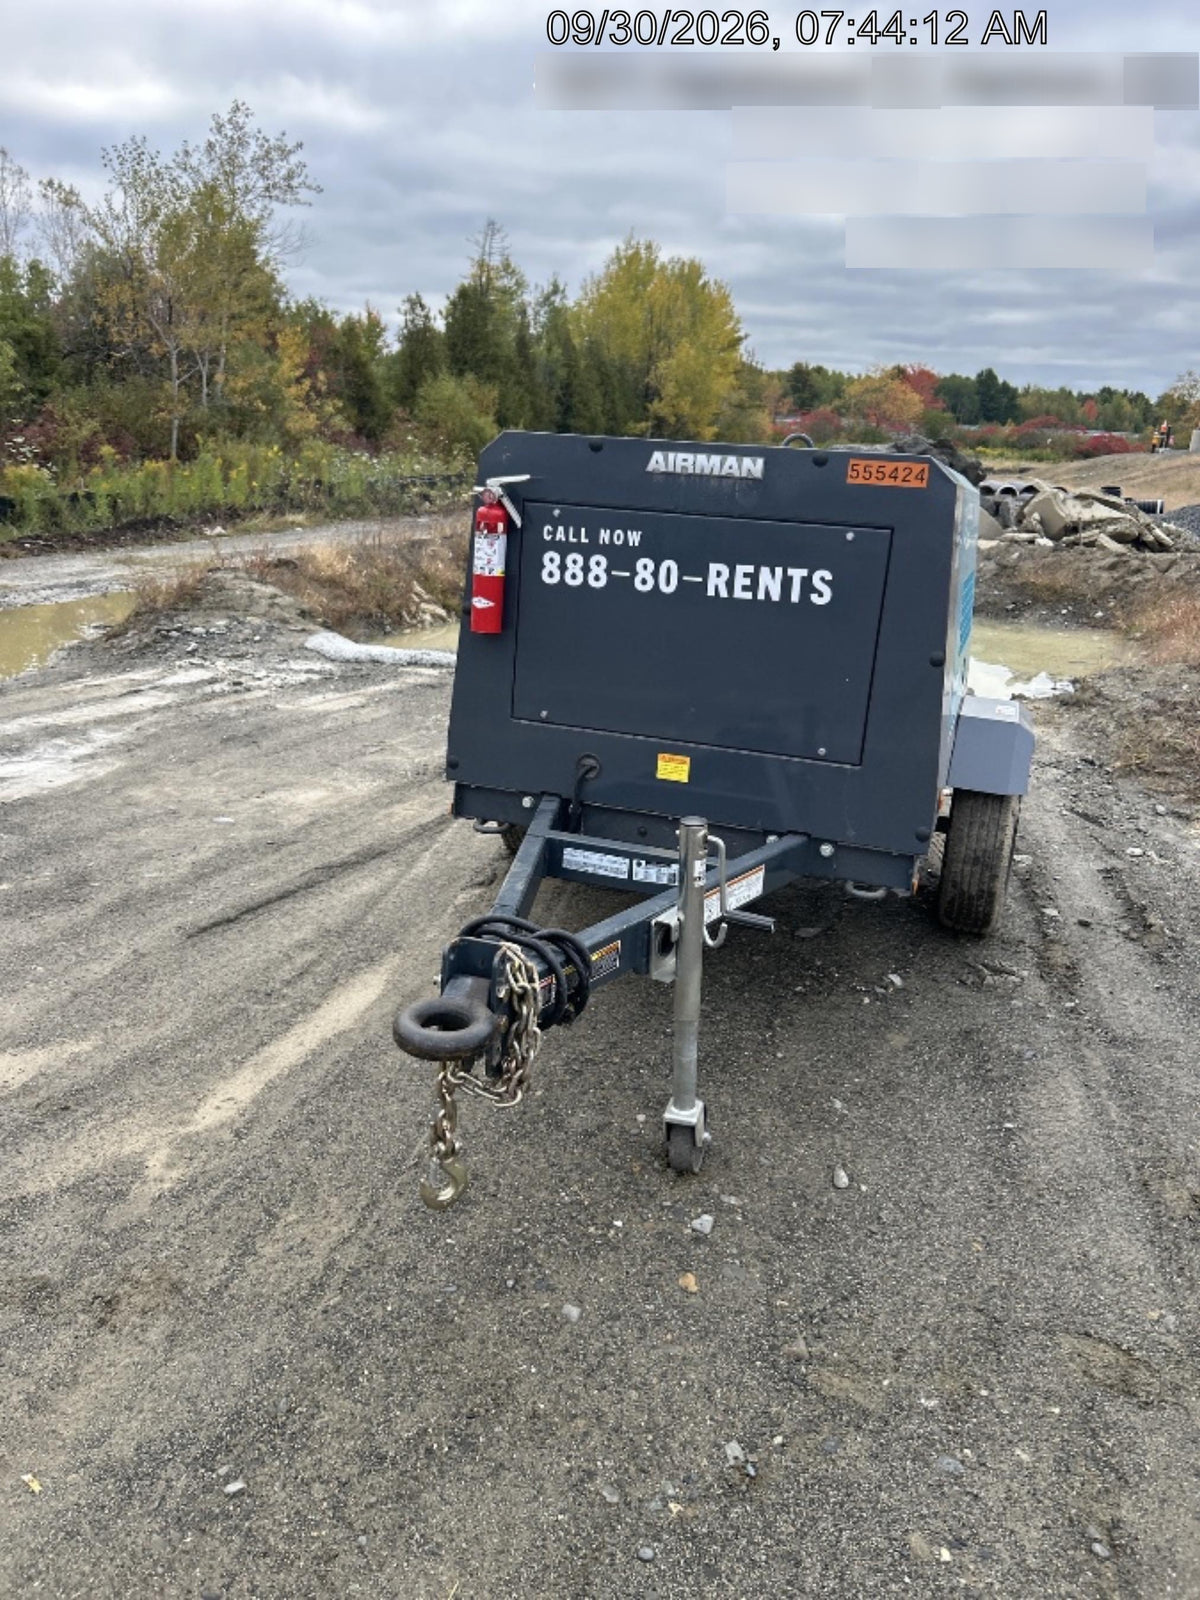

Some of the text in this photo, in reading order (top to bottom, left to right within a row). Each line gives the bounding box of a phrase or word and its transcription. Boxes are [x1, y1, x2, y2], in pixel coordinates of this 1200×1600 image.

[646, 450, 765, 480] AIRMAN
[849, 462, 926, 484] 555424
[543, 525, 642, 547] CALL NOW
[541, 550, 833, 606] 888-80-RENTS
